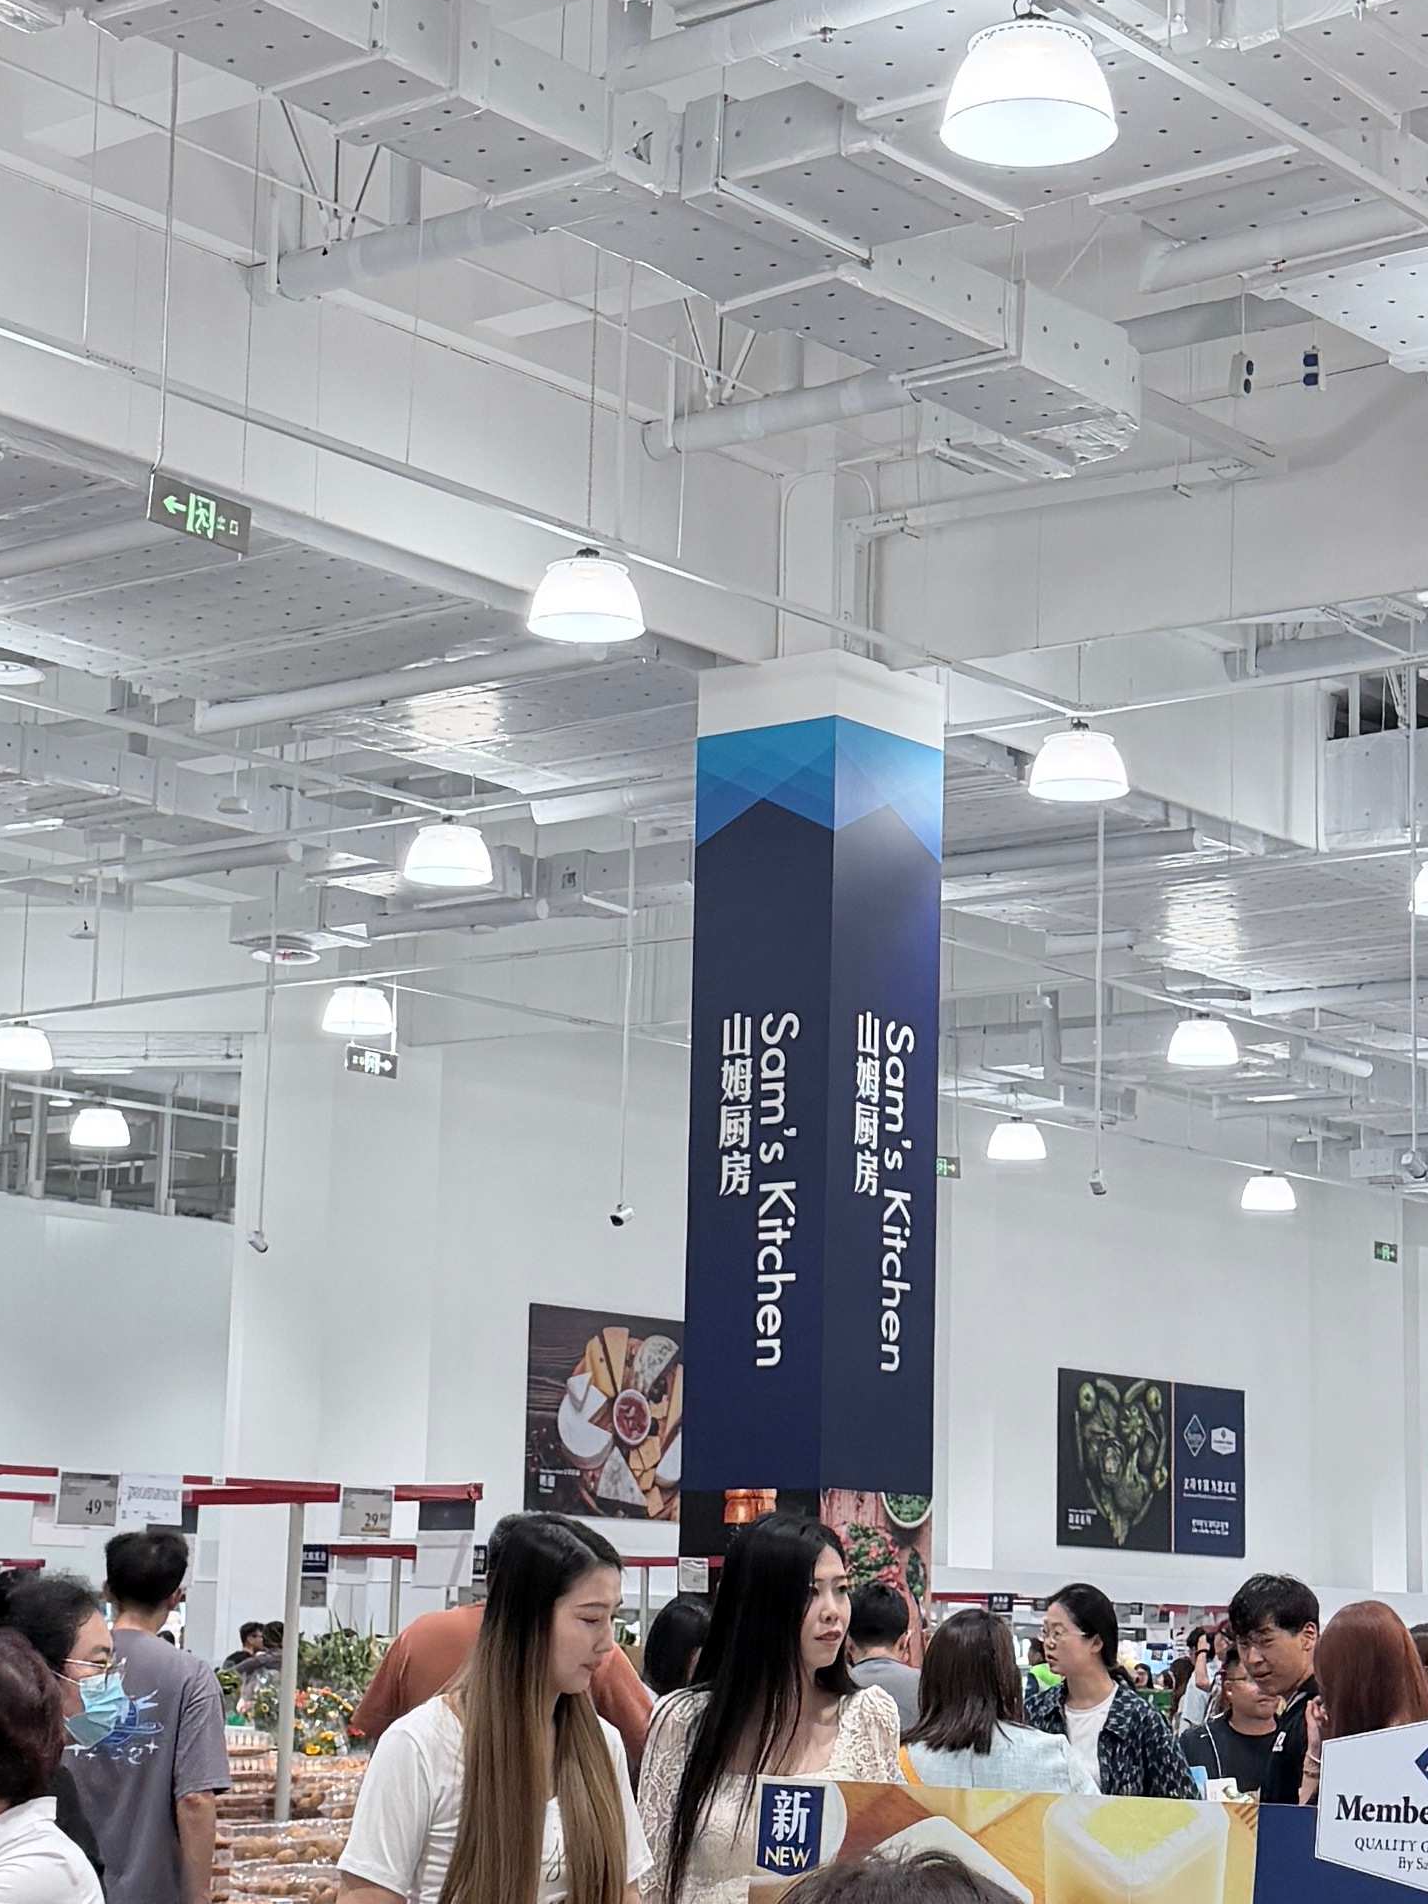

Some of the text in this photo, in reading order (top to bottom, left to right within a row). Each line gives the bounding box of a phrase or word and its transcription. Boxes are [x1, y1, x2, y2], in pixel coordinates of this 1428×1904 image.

[719, 1012, 754, 1196] 山姆厨房
[854, 1010, 880, 1197] 山姆厨房
[755, 1011, 800, 1368] Sam's Kitchen
[880, 1025, 915, 1372] Sam's Kitchen
[765, 1846, 812, 1868] NEW
[771, 1789, 812, 1844] 新
[1354, 1837, 1417, 1854] QUALITY
[1398, 1857, 1413, 1871] By
